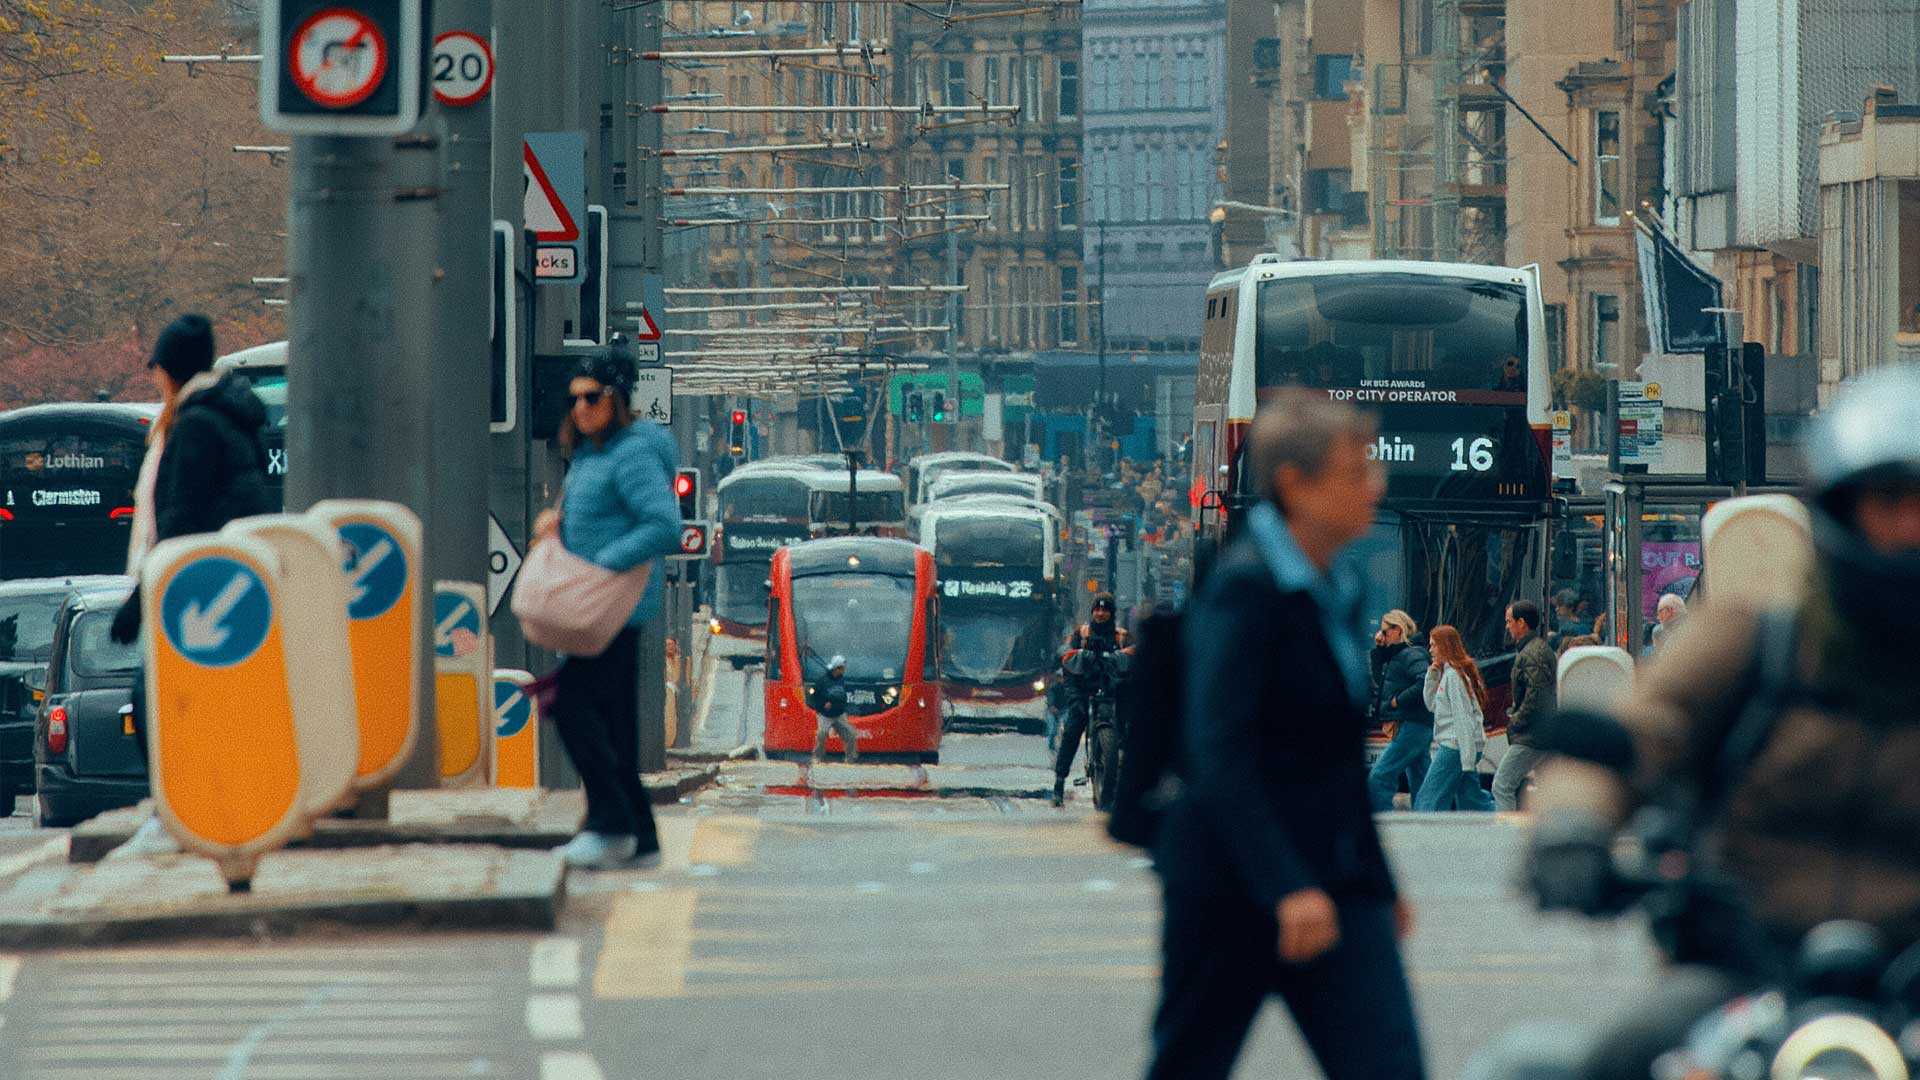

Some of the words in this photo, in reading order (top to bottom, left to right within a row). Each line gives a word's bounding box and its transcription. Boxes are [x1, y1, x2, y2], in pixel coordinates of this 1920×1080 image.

[433, 53, 482, 81] 20
[535, 255, 569, 269] cks
[1390, 380, 1426, 389] AWARDS
[1328, 389, 1354, 401] TOP
[1356, 390, 1386, 402] CITY
[1388, 390, 1457, 402] OPERATOR
[46, 453, 104, 469] Lothian
[1450, 437, 1494, 472] 16
[32, 489, 101, 506] Clermiston
[1008, 580, 1033, 598] 25
